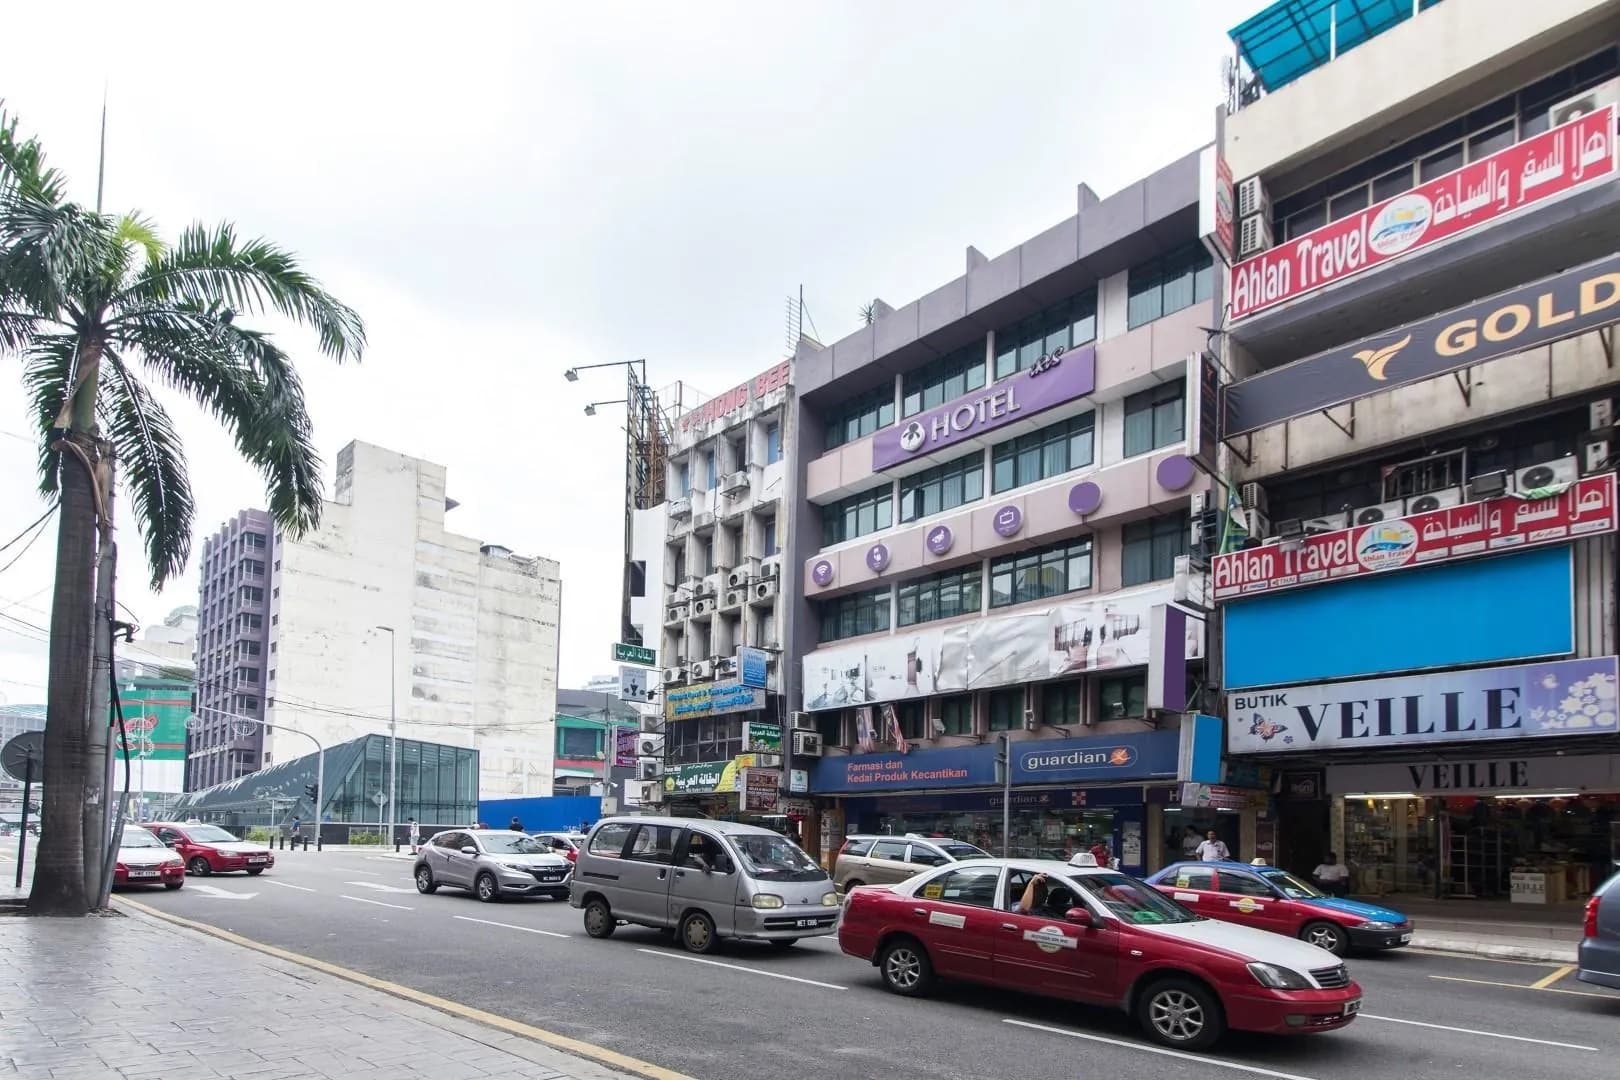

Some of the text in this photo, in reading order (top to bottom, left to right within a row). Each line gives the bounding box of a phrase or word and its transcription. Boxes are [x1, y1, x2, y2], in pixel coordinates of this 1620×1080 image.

[1234, 214, 1366, 312] Ahlan Travel
[1434, 273, 1620, 357] GOLD
[755, 359, 791, 399] BEE
[931, 386, 1021, 442] HOTEL
[1215, 531, 1354, 588] Ahlan Travel
[1235, 693, 1288, 710] BUTIK
[1294, 687, 1521, 742] VEILLE
[847, 760, 903, 771] Farmasi dan
[847, 768, 968, 783] Kedai Produk Kecantikan
[1028, 751, 1107, 770] guardian
[1408, 761, 1528, 789] VEILLE
